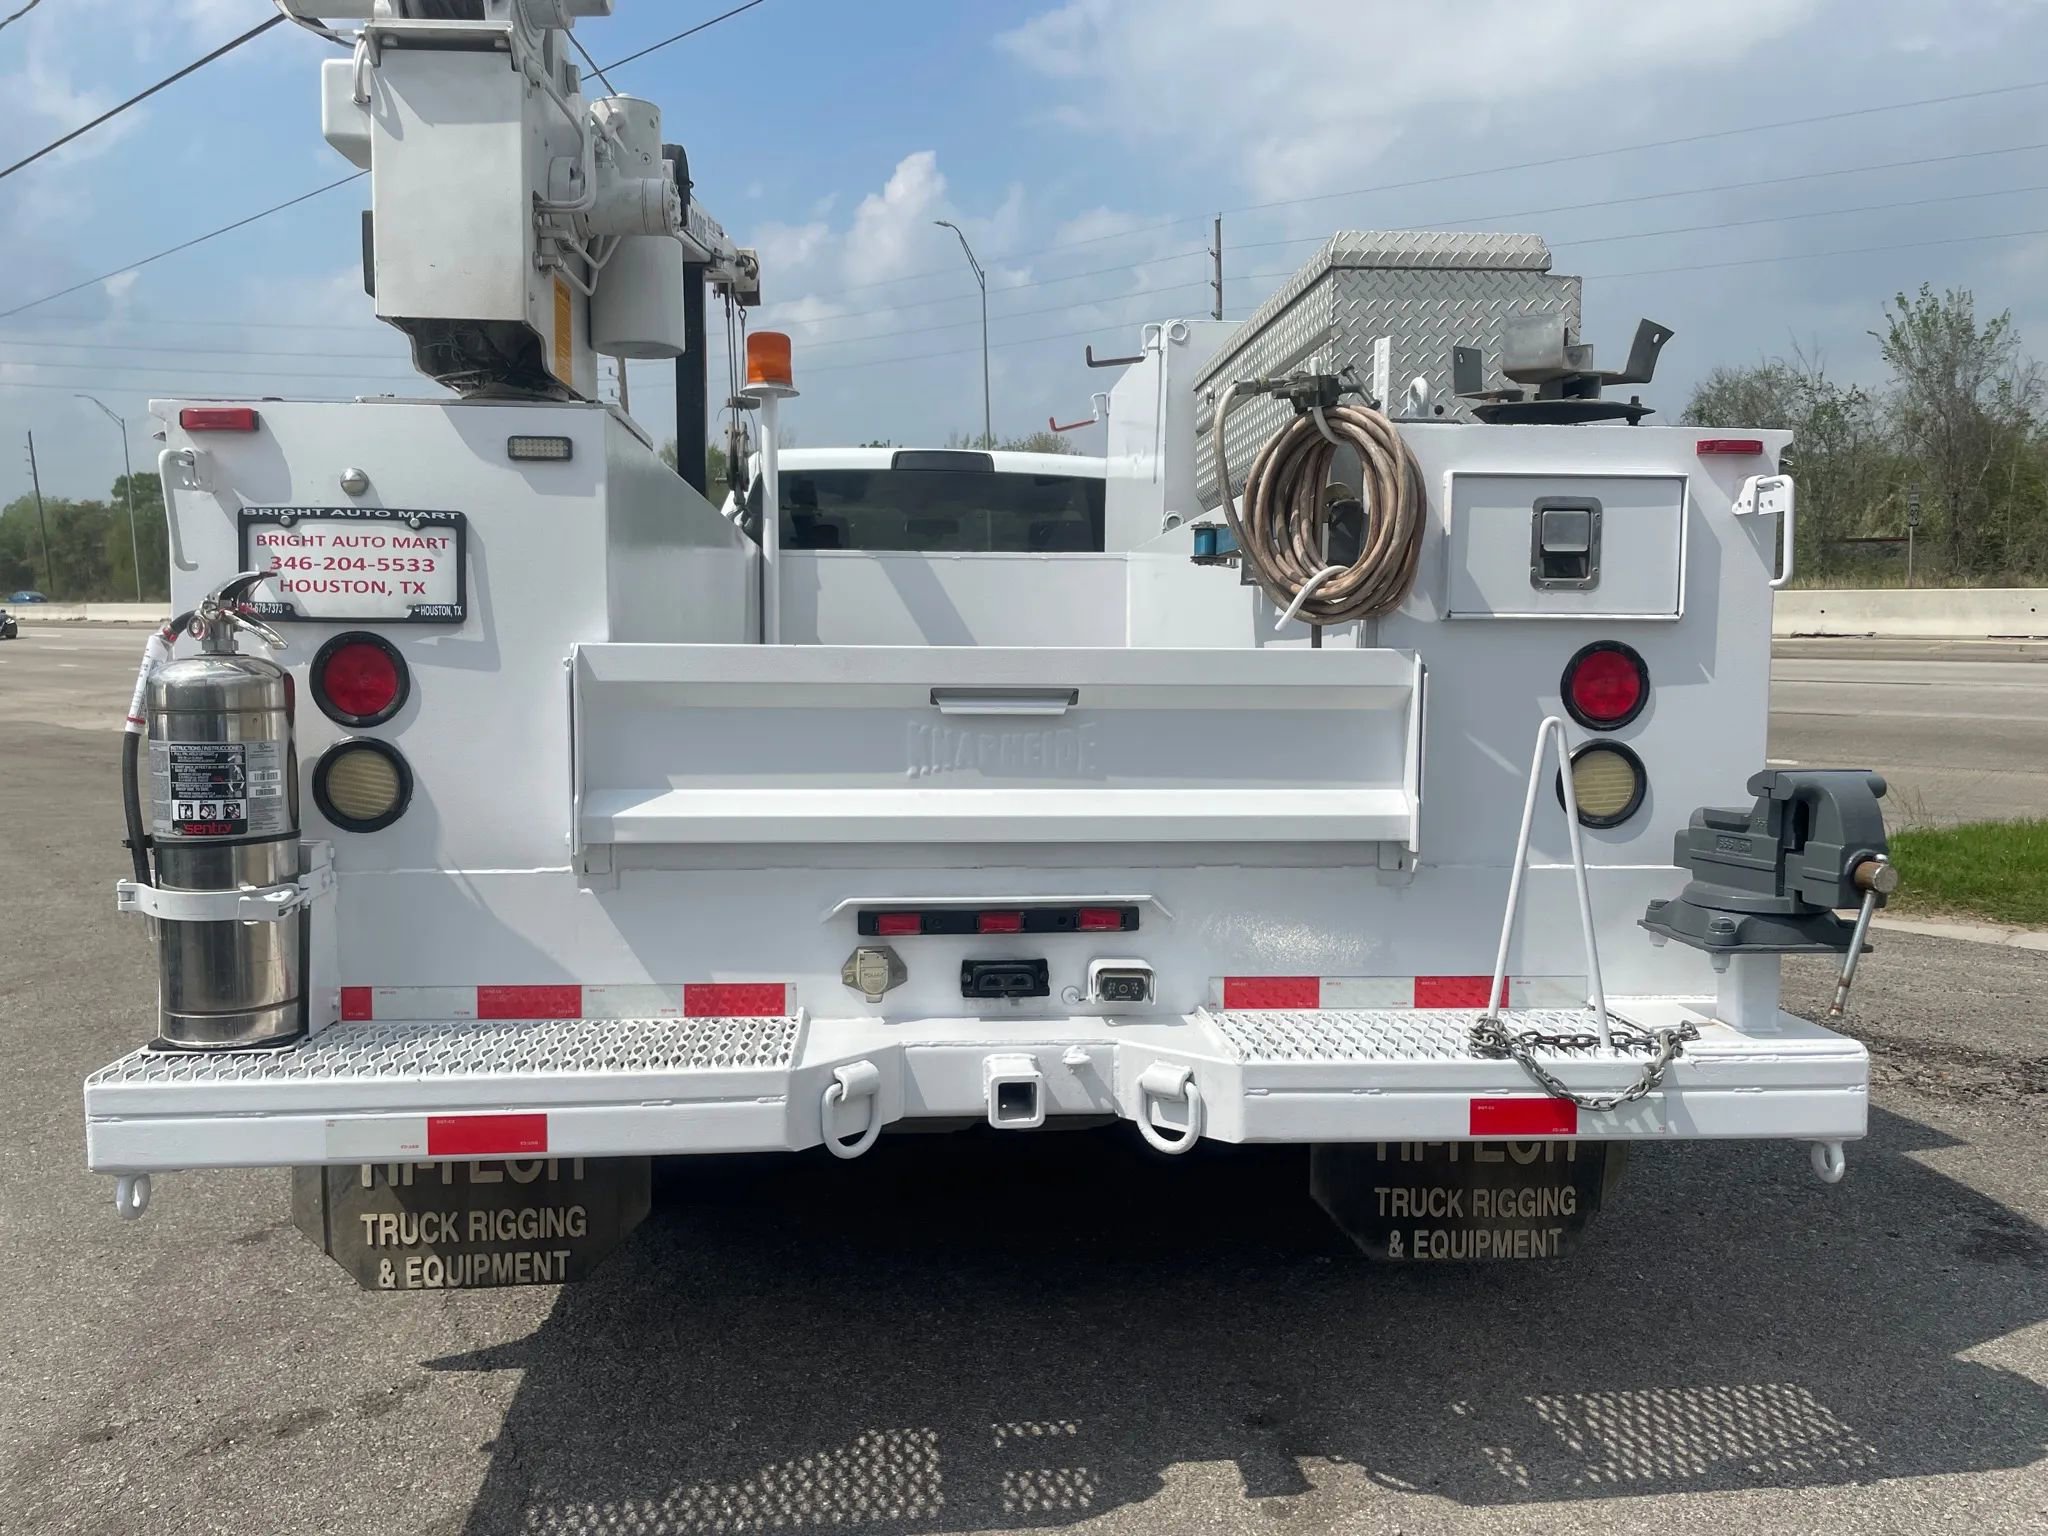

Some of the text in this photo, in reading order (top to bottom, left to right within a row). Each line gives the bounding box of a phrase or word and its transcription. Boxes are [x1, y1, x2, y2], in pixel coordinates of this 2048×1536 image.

[243, 508, 460, 519] BRIGHT AUTO MART
[256, 535, 449, 549] BRIGHT AUTO MART
[270, 556, 436, 572] 346-204-5533
[279, 579, 426, 596] HOUSTON, TX
[420, 605, 463, 617] HOUSTON, TX
[183, 822, 232, 835] sentry
[1374, 1185, 1577, 1218] TRUCK RIGGING
[360, 1206, 587, 1246] TRUCK RIGGING
[1387, 1228, 1563, 1259] & EQUIPMENT
[378, 1250, 571, 1289] & EQUIPMENT
